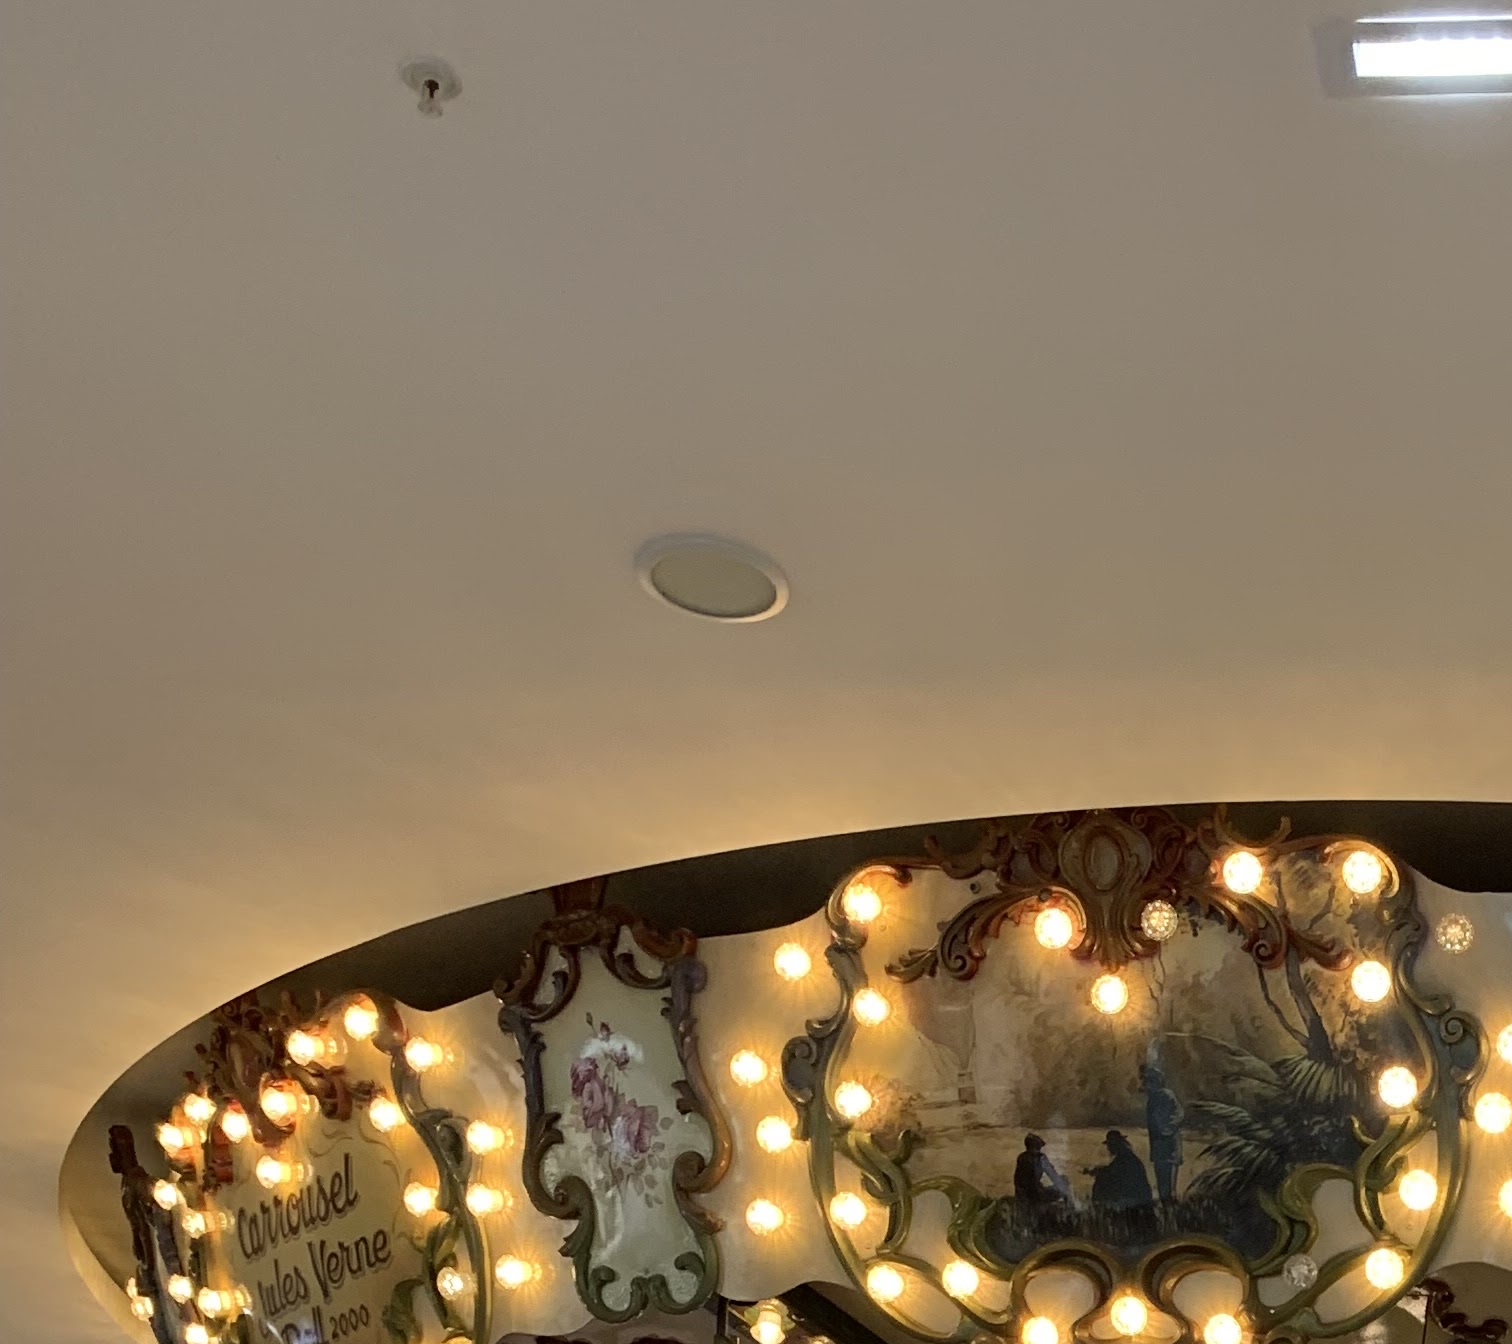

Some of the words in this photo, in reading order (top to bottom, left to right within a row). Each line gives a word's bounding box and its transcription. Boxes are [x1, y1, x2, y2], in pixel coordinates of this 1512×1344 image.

[237, 1152, 359, 1263] Carrousel
[307, 1228, 392, 1300] Verne
[329, 1303, 370, 1341] 2000
